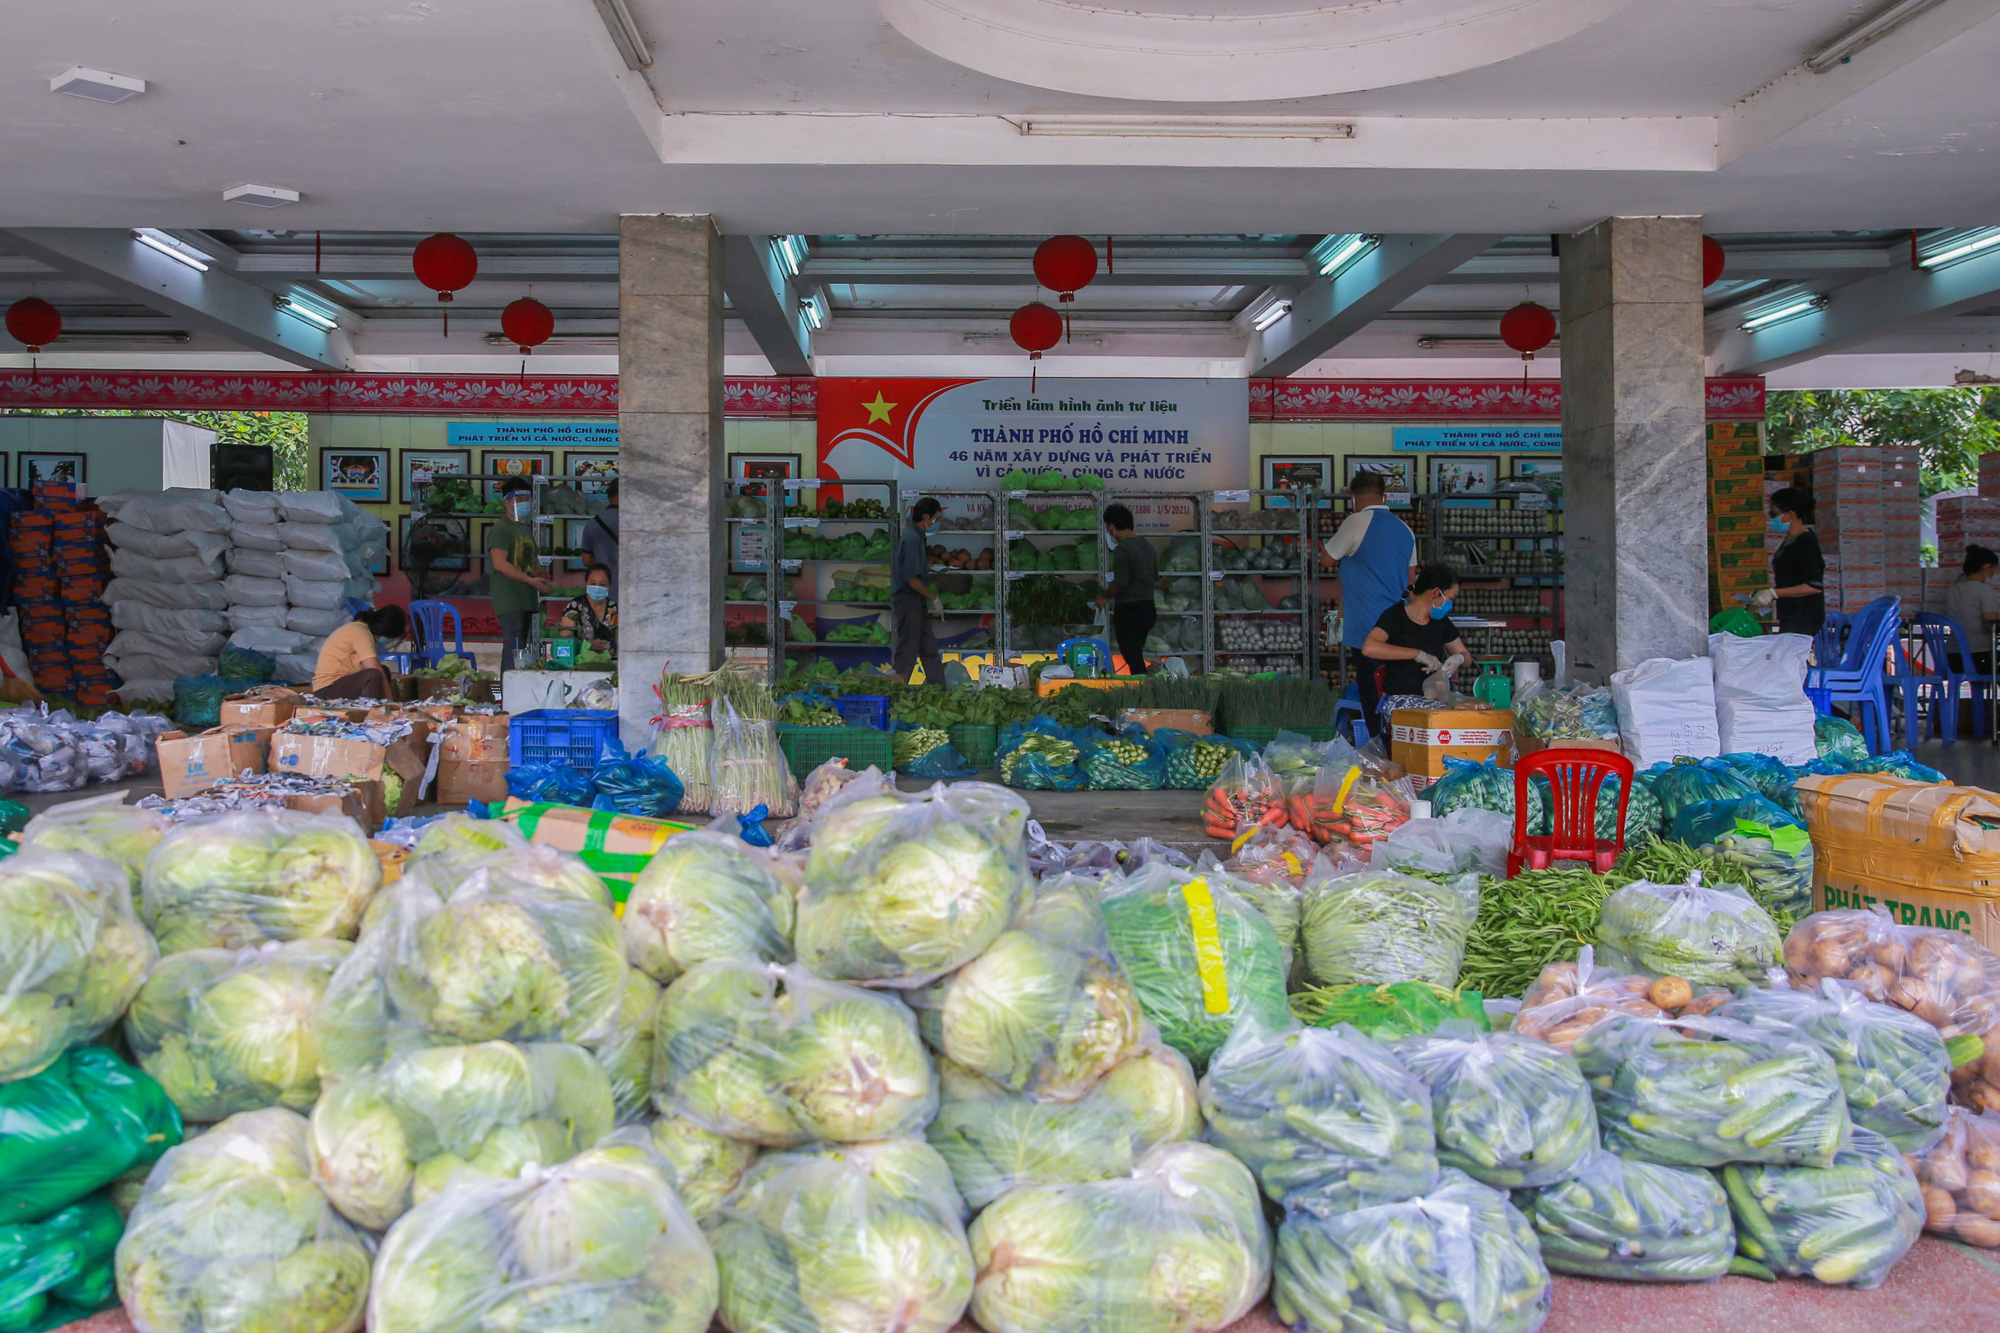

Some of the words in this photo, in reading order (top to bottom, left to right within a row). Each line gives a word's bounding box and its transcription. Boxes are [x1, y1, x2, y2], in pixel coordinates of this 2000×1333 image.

[982, 397, 1021, 411] Triển
[1027, 399, 1054, 411] lãm
[1059, 397, 1091, 411] hình
[1096, 399, 1124, 412] ảnh
[1128, 401, 1146, 412] tư
[1150, 400, 1177, 414] liệu
[488, 433, 518, 441] TRIỂN
[534, 425, 555, 434] PHỐ
[575, 426, 593, 434] CHÍ
[971, 425, 1034, 443] THÀNH
[1039, 422, 1074, 443] PHỐ
[1079, 422, 1103, 443] HỒ
[1108, 426, 1139, 444] CHÍ
[1143, 430, 1189, 444] MINH
[1481, 430, 1503, 438] PHỐ
[1435, 439, 1466, 447] TRIỂN
[1482, 439, 1495, 447] CẢ
[949, 451, 968, 461] 46
[974, 449, 1007, 462] NĂM
[1013, 449, 1043, 462] XÂY
[1049, 450, 1090, 464] DỰNG
[1095, 450, 1114, 462] VÀ
[1120, 450, 1160, 463] PHÁT
[1165, 447, 1211, 463] TRIỂN
[976, 465, 990, 477] VÌ
[1118, 464, 1138, 478] CẢ
[1144, 466, 1185, 479] NƯỚC
[1884, 899, 1971, 936] TRANG
